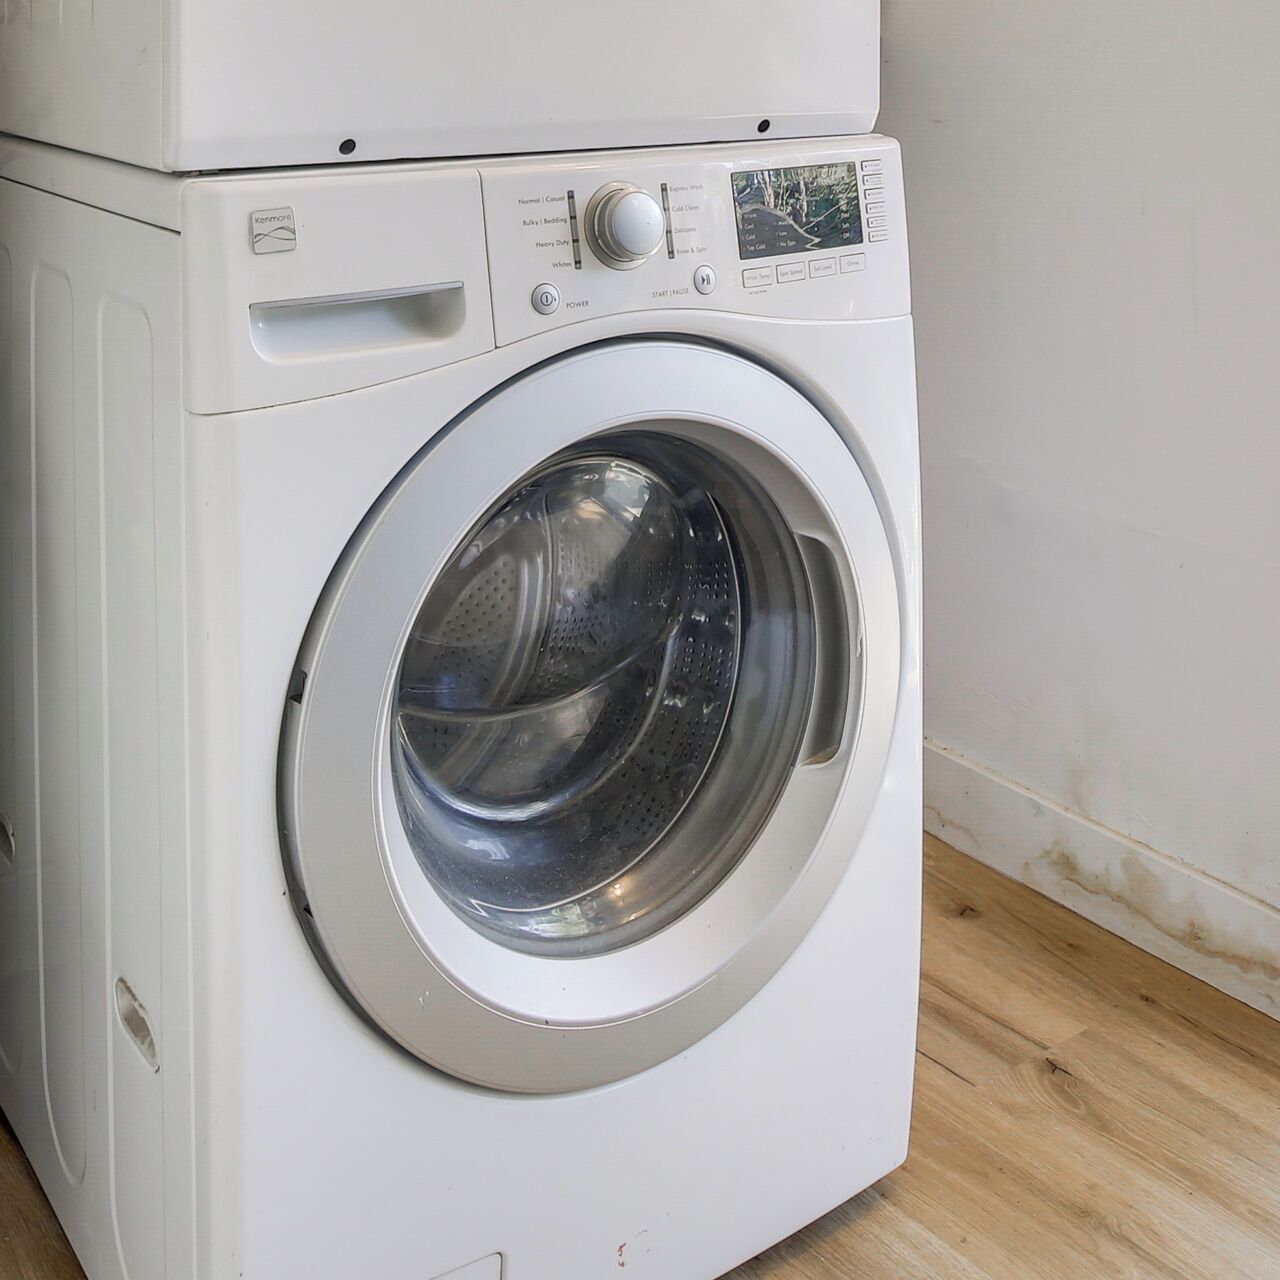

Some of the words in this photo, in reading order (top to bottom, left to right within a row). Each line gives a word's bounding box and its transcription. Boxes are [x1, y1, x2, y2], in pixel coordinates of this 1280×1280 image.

[518, 197, 541, 205] Normal
[546, 195, 565, 203] Casual
[255, 214, 291, 224] Kenmore
[544, 217, 567, 225] Bedding
[536, 240, 554, 248] Heavy
[556, 239, 569, 247] Duty
[652, 289, 668, 298] START
[566, 300, 589, 309] POWER
